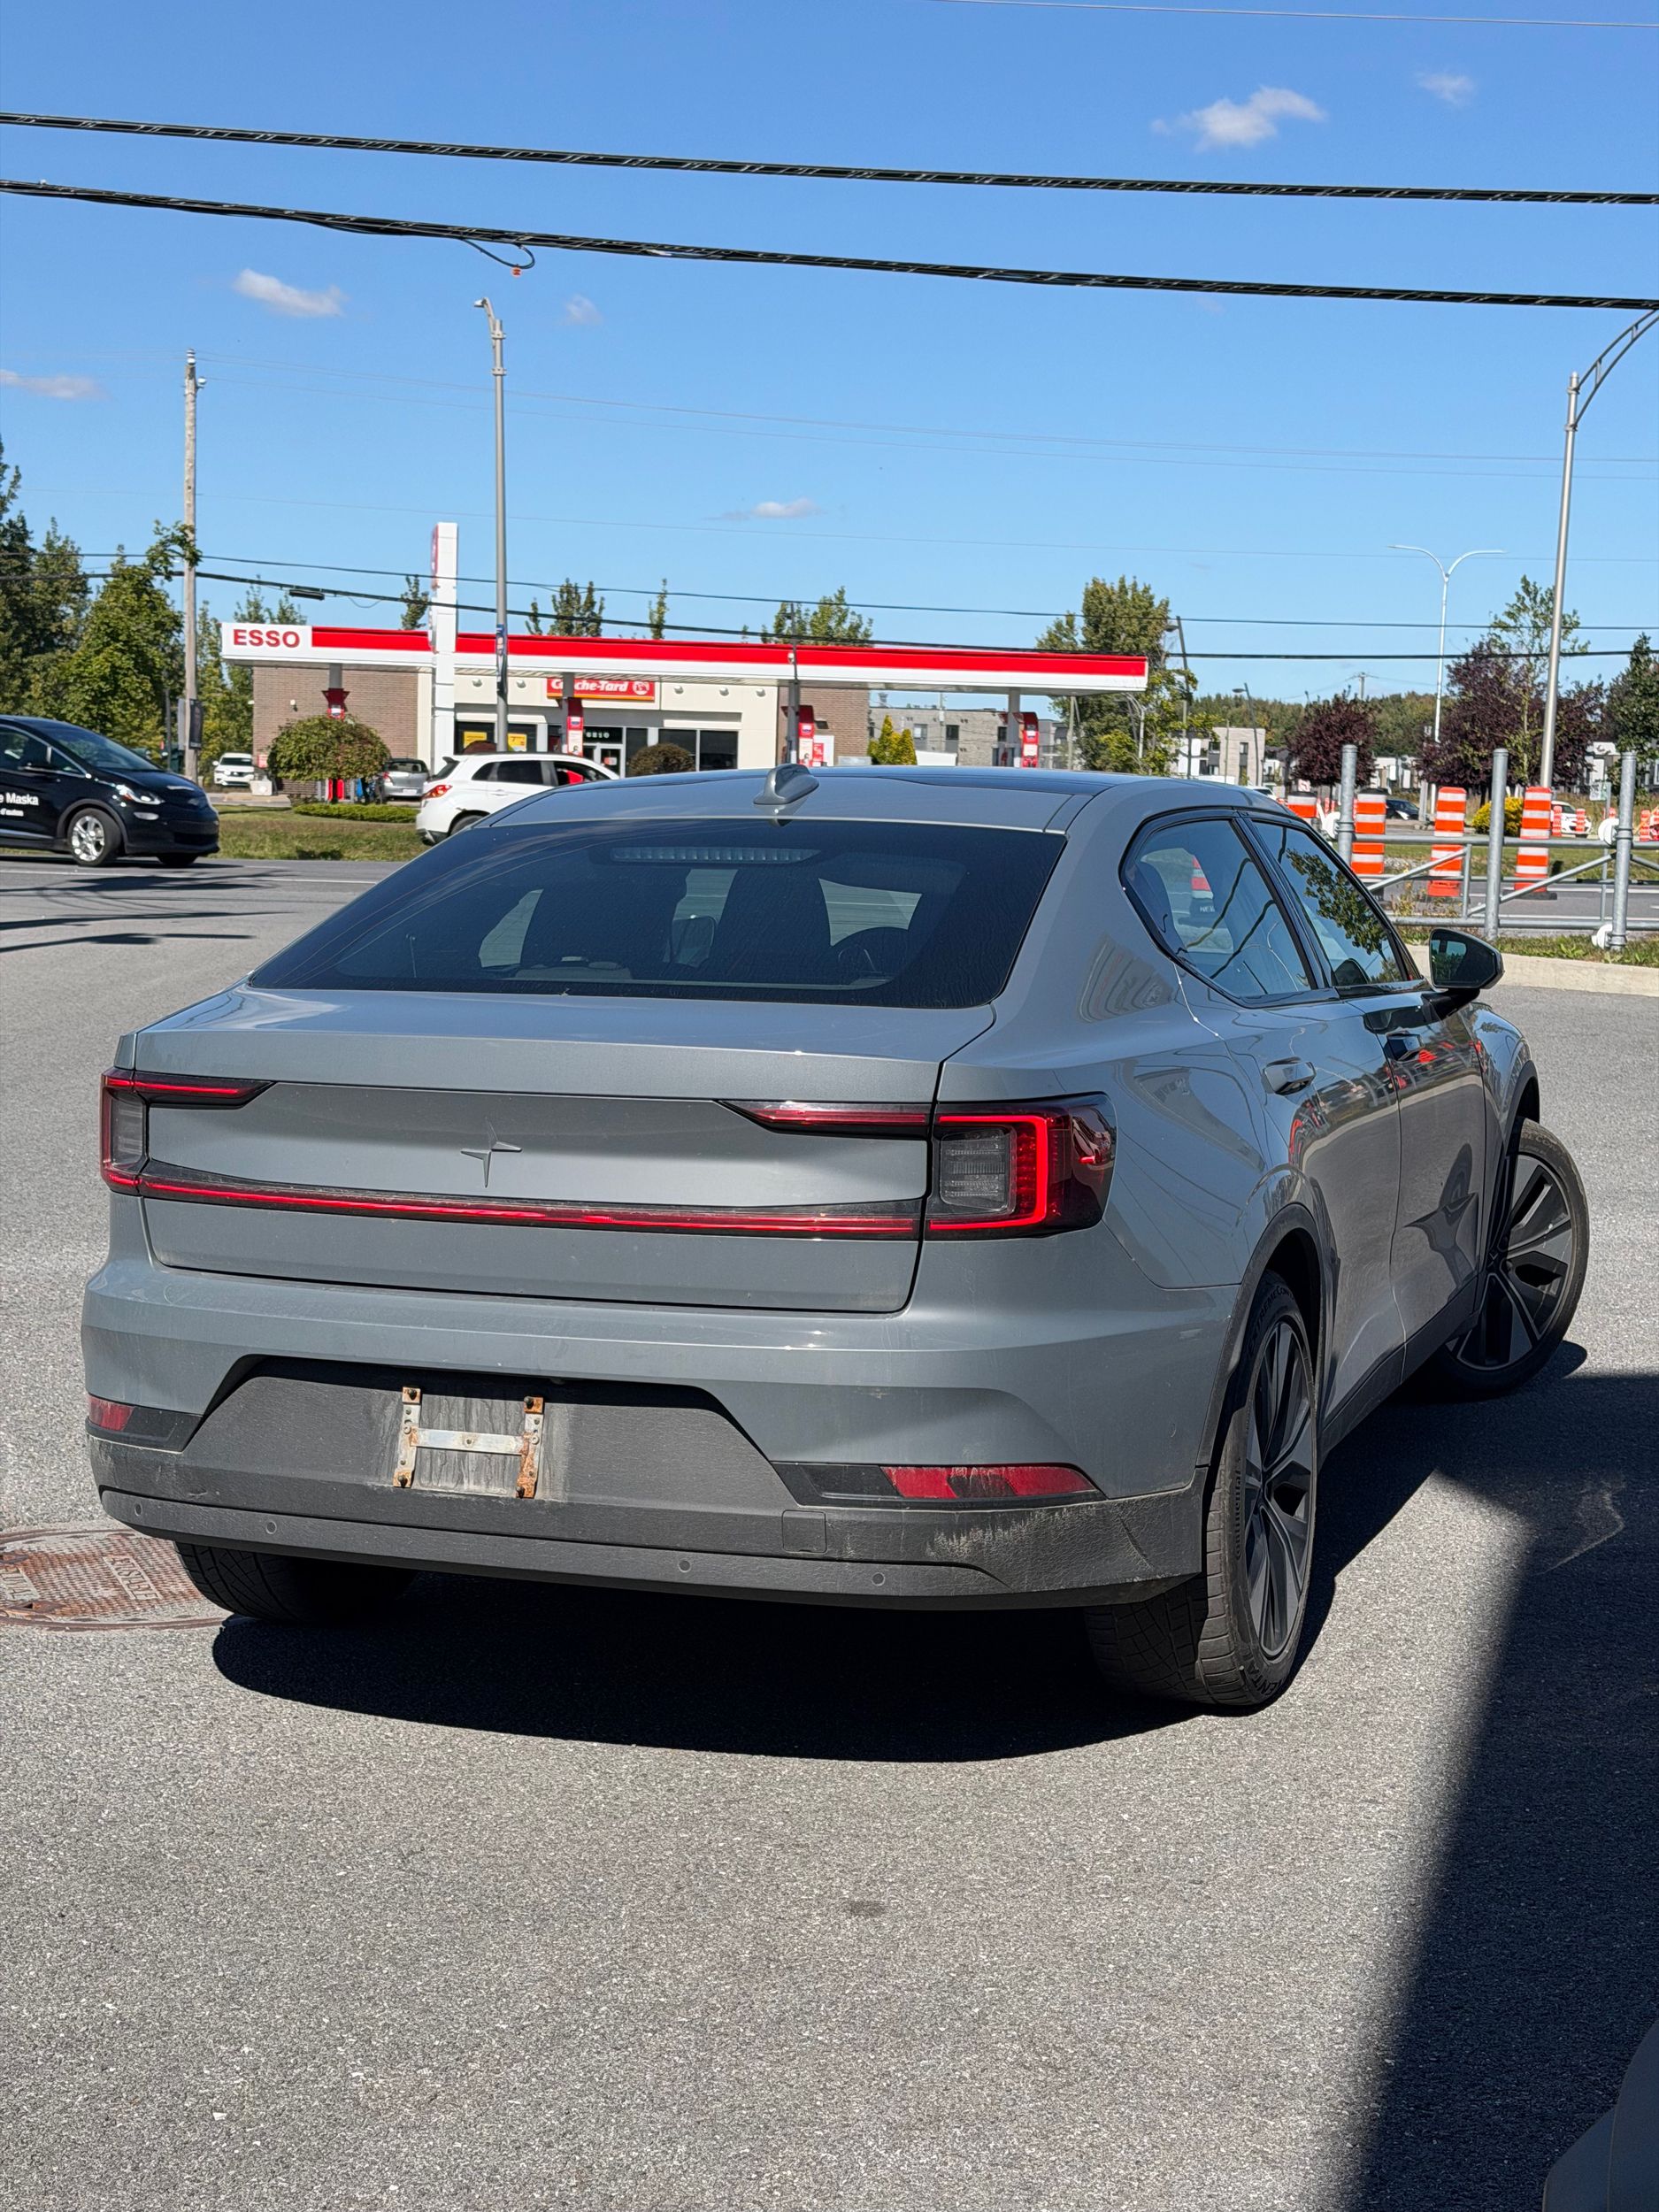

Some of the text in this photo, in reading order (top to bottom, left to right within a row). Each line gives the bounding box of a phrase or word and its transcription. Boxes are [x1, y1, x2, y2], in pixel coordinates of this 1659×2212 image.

[233, 629, 300, 648] ESSO
[550, 679, 629, 692] Cche-Tard
[5, 792, 39, 806] Maska
